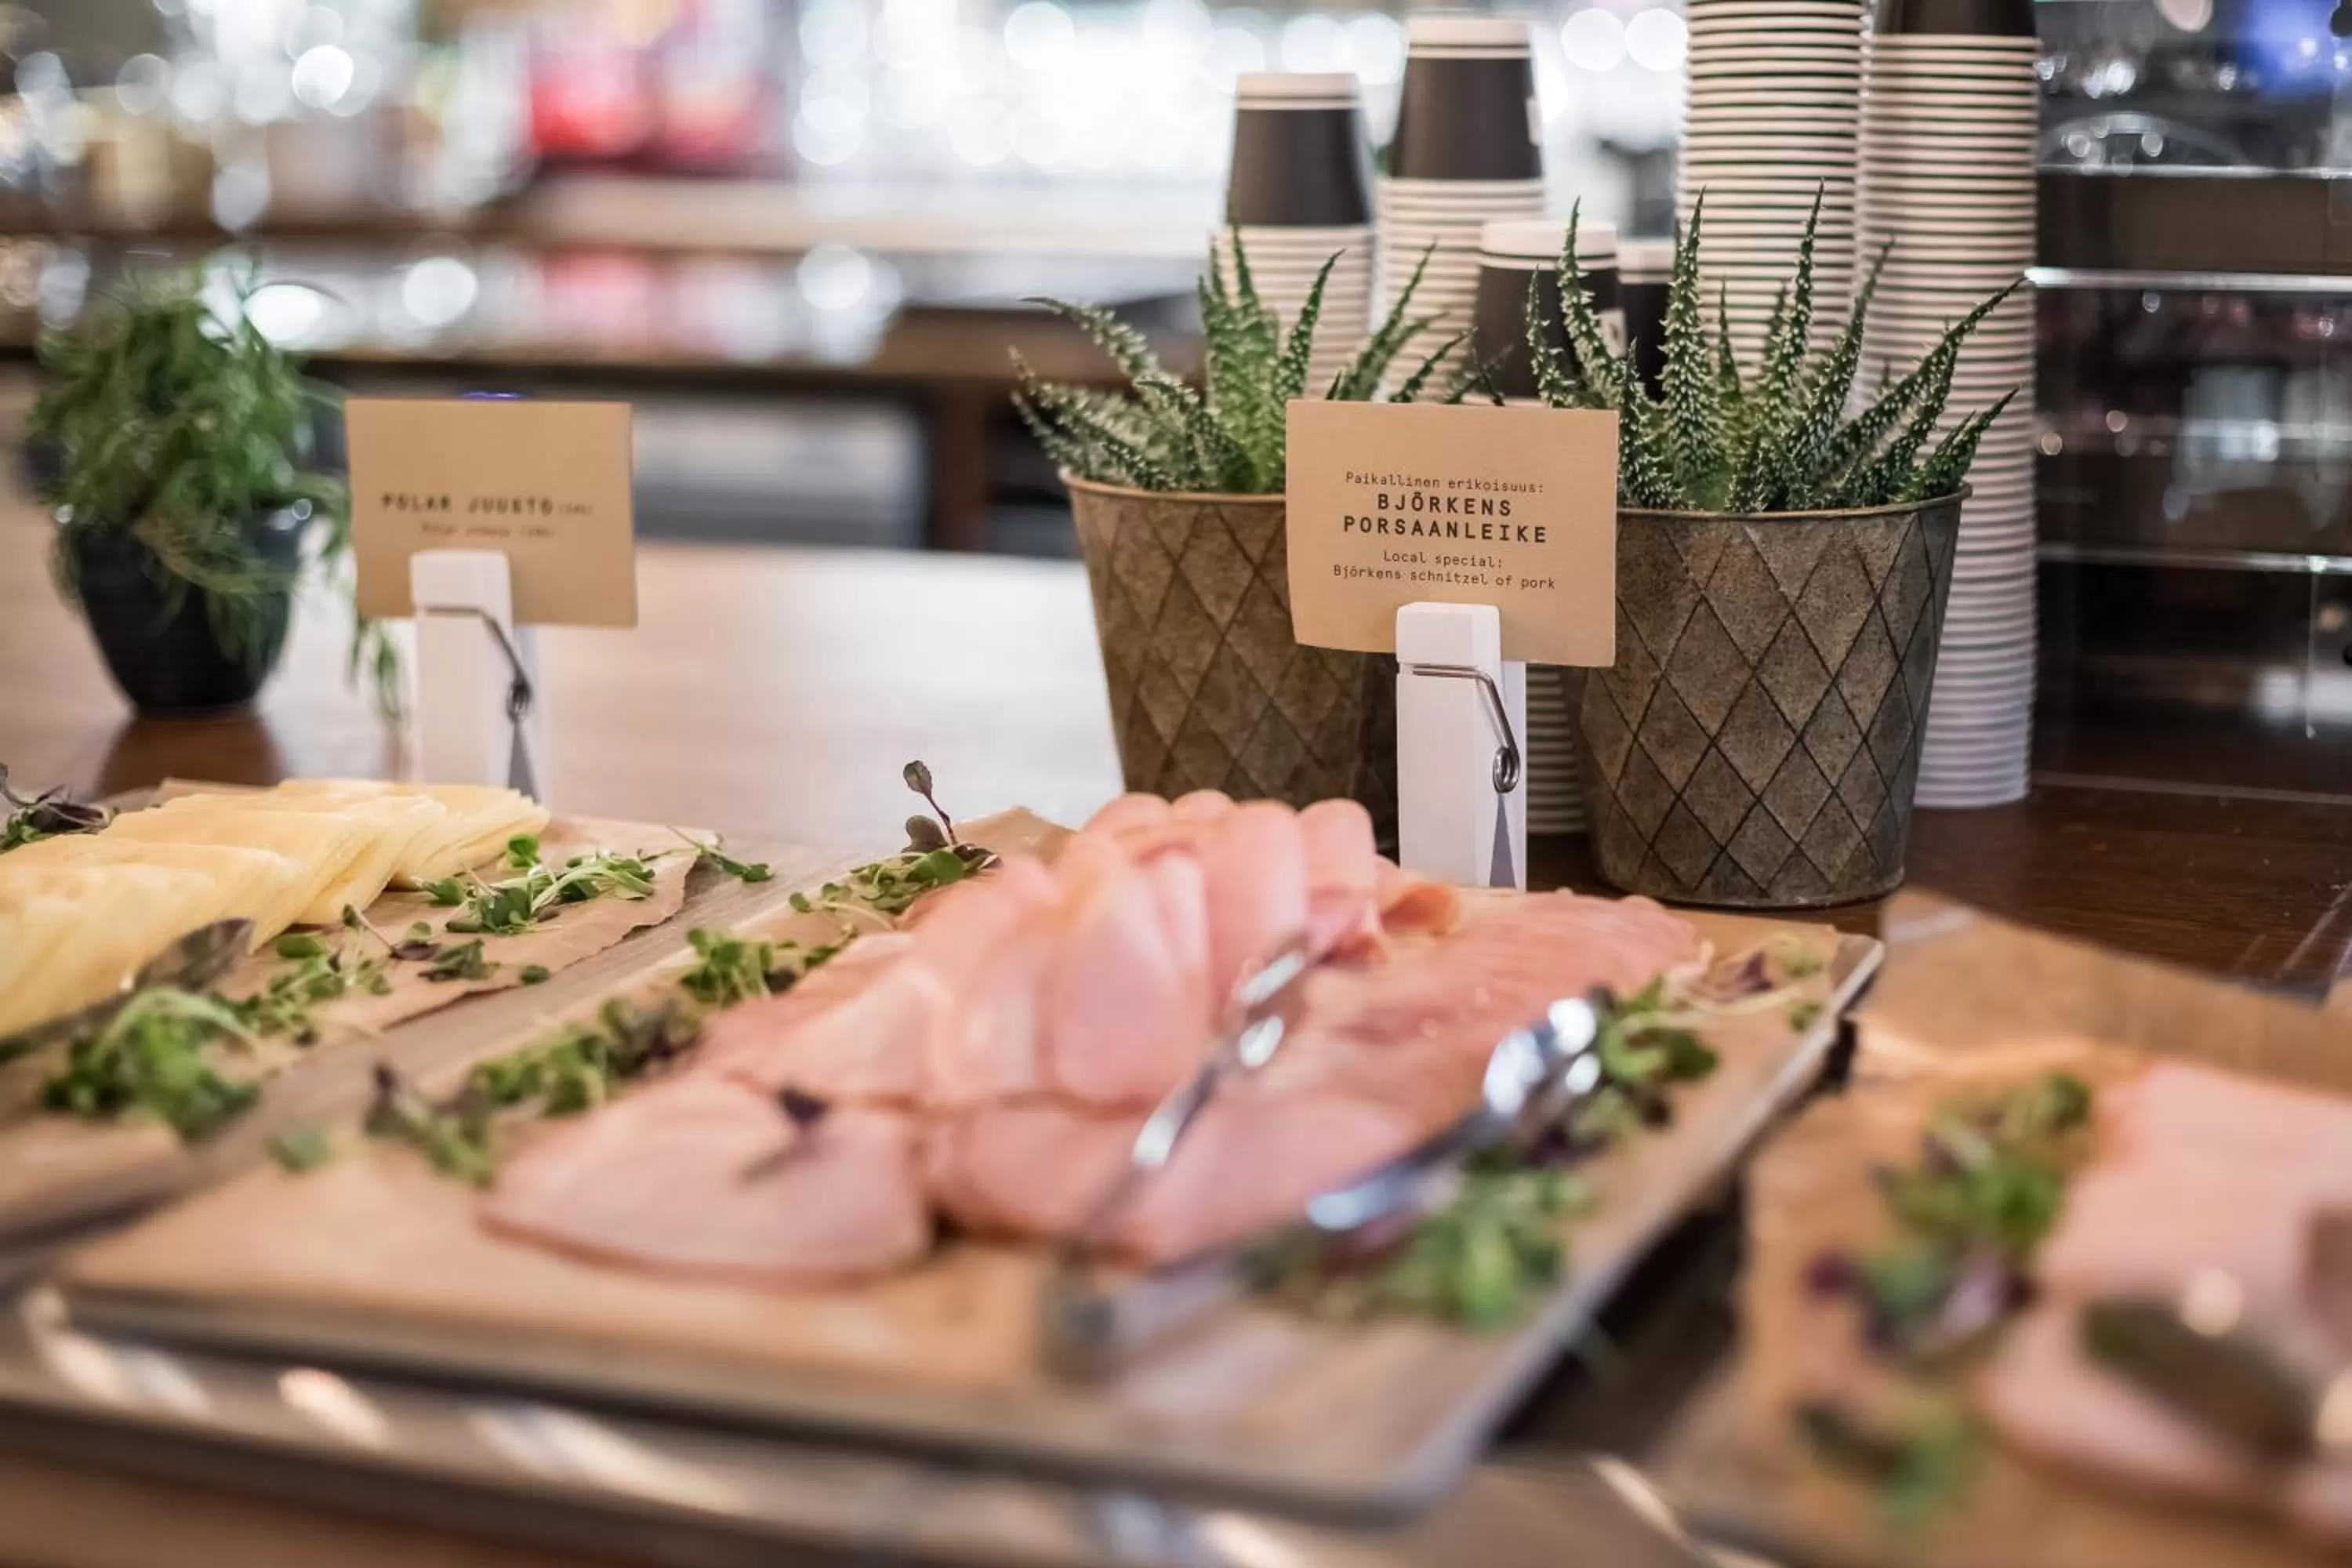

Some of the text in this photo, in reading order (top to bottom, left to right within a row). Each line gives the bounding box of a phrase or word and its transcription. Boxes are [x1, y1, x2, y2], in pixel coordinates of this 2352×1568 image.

[1345, 471, 1544, 493] Paikallinen erikoisuus:
[1377, 492, 1512, 516] BJÖRKENS
[1344, 516, 1547, 543] PORSAANLEIKE
[1383, 551, 1503, 569] Local special:
[1334, 564, 1555, 590] Björkens schnitzel of pork
